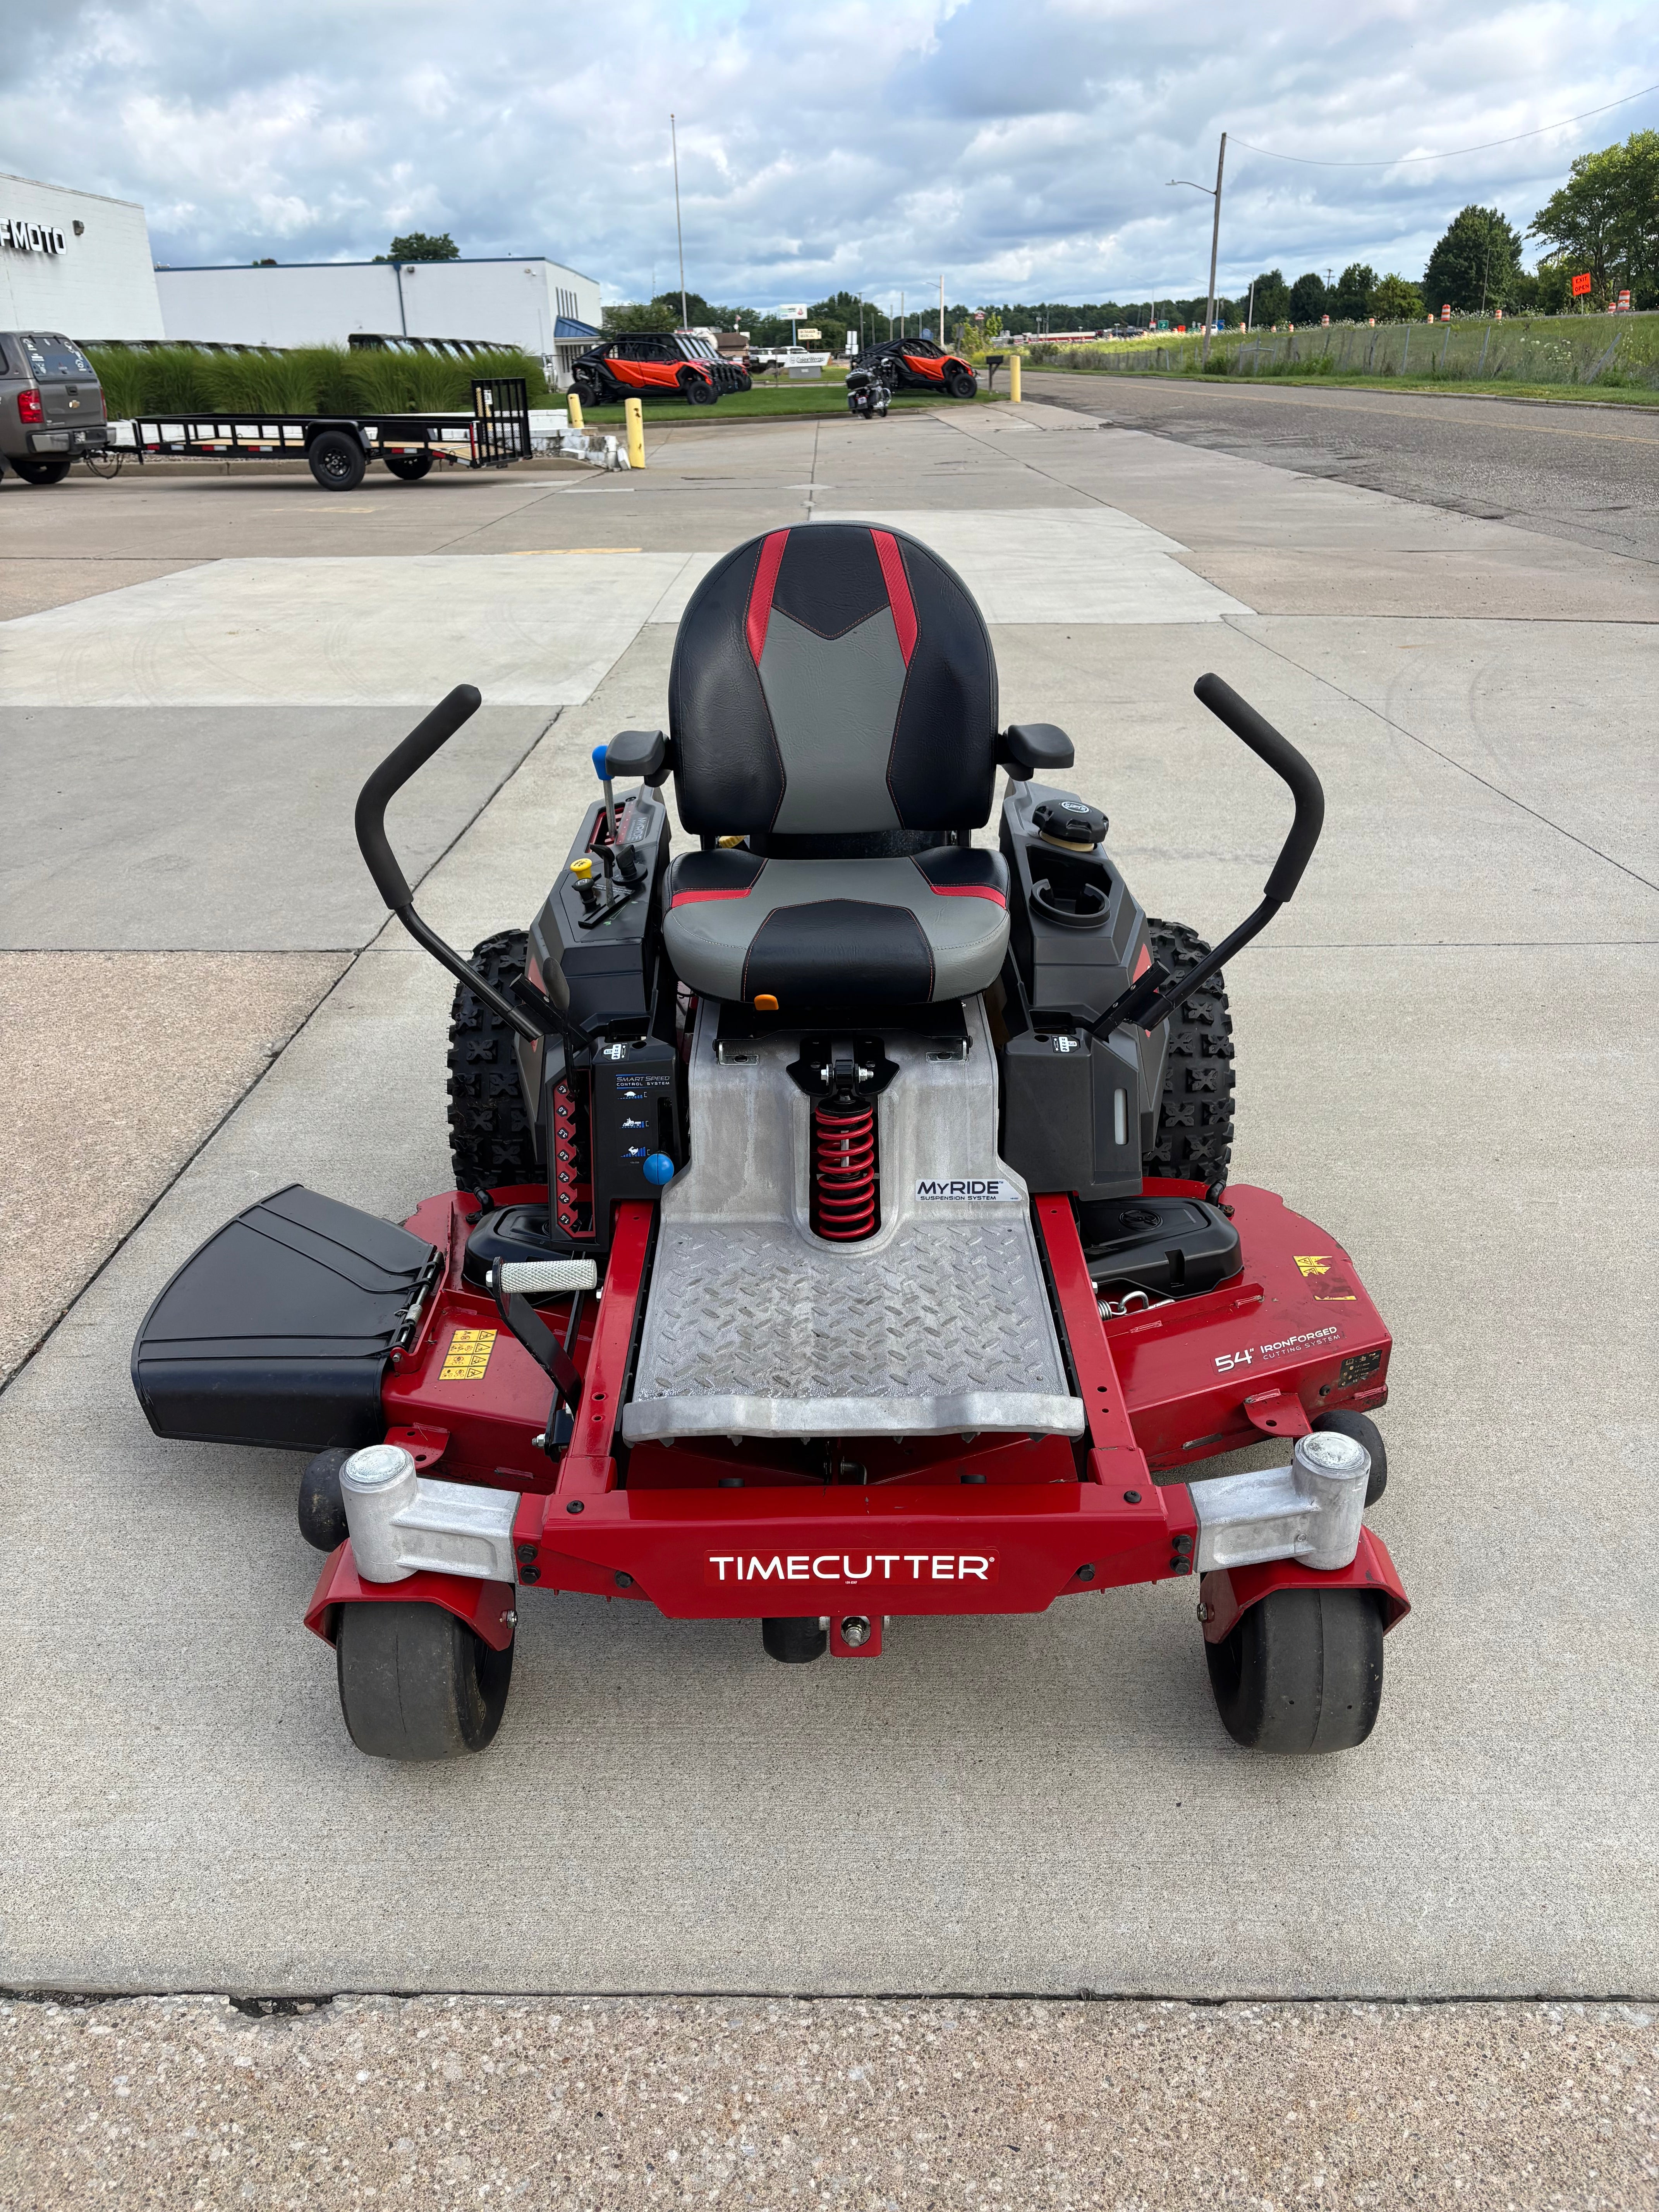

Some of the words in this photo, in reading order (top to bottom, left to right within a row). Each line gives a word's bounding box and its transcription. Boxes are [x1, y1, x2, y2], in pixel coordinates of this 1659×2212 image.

[1575, 283, 1589, 292] OPEN
[558, 1107, 567, 1115] 4.0
[559, 1129, 568, 1138] 3.5
[560, 1151, 568, 1160] 3.0
[560, 1173, 569, 1181] 2.5
[560, 1194, 569, 1202] 2.0
[561, 1215, 569, 1224] 1.5
[1263, 1346, 1302, 1360] CUTTING
[1304, 1334, 1340, 1348] SYSTEM
